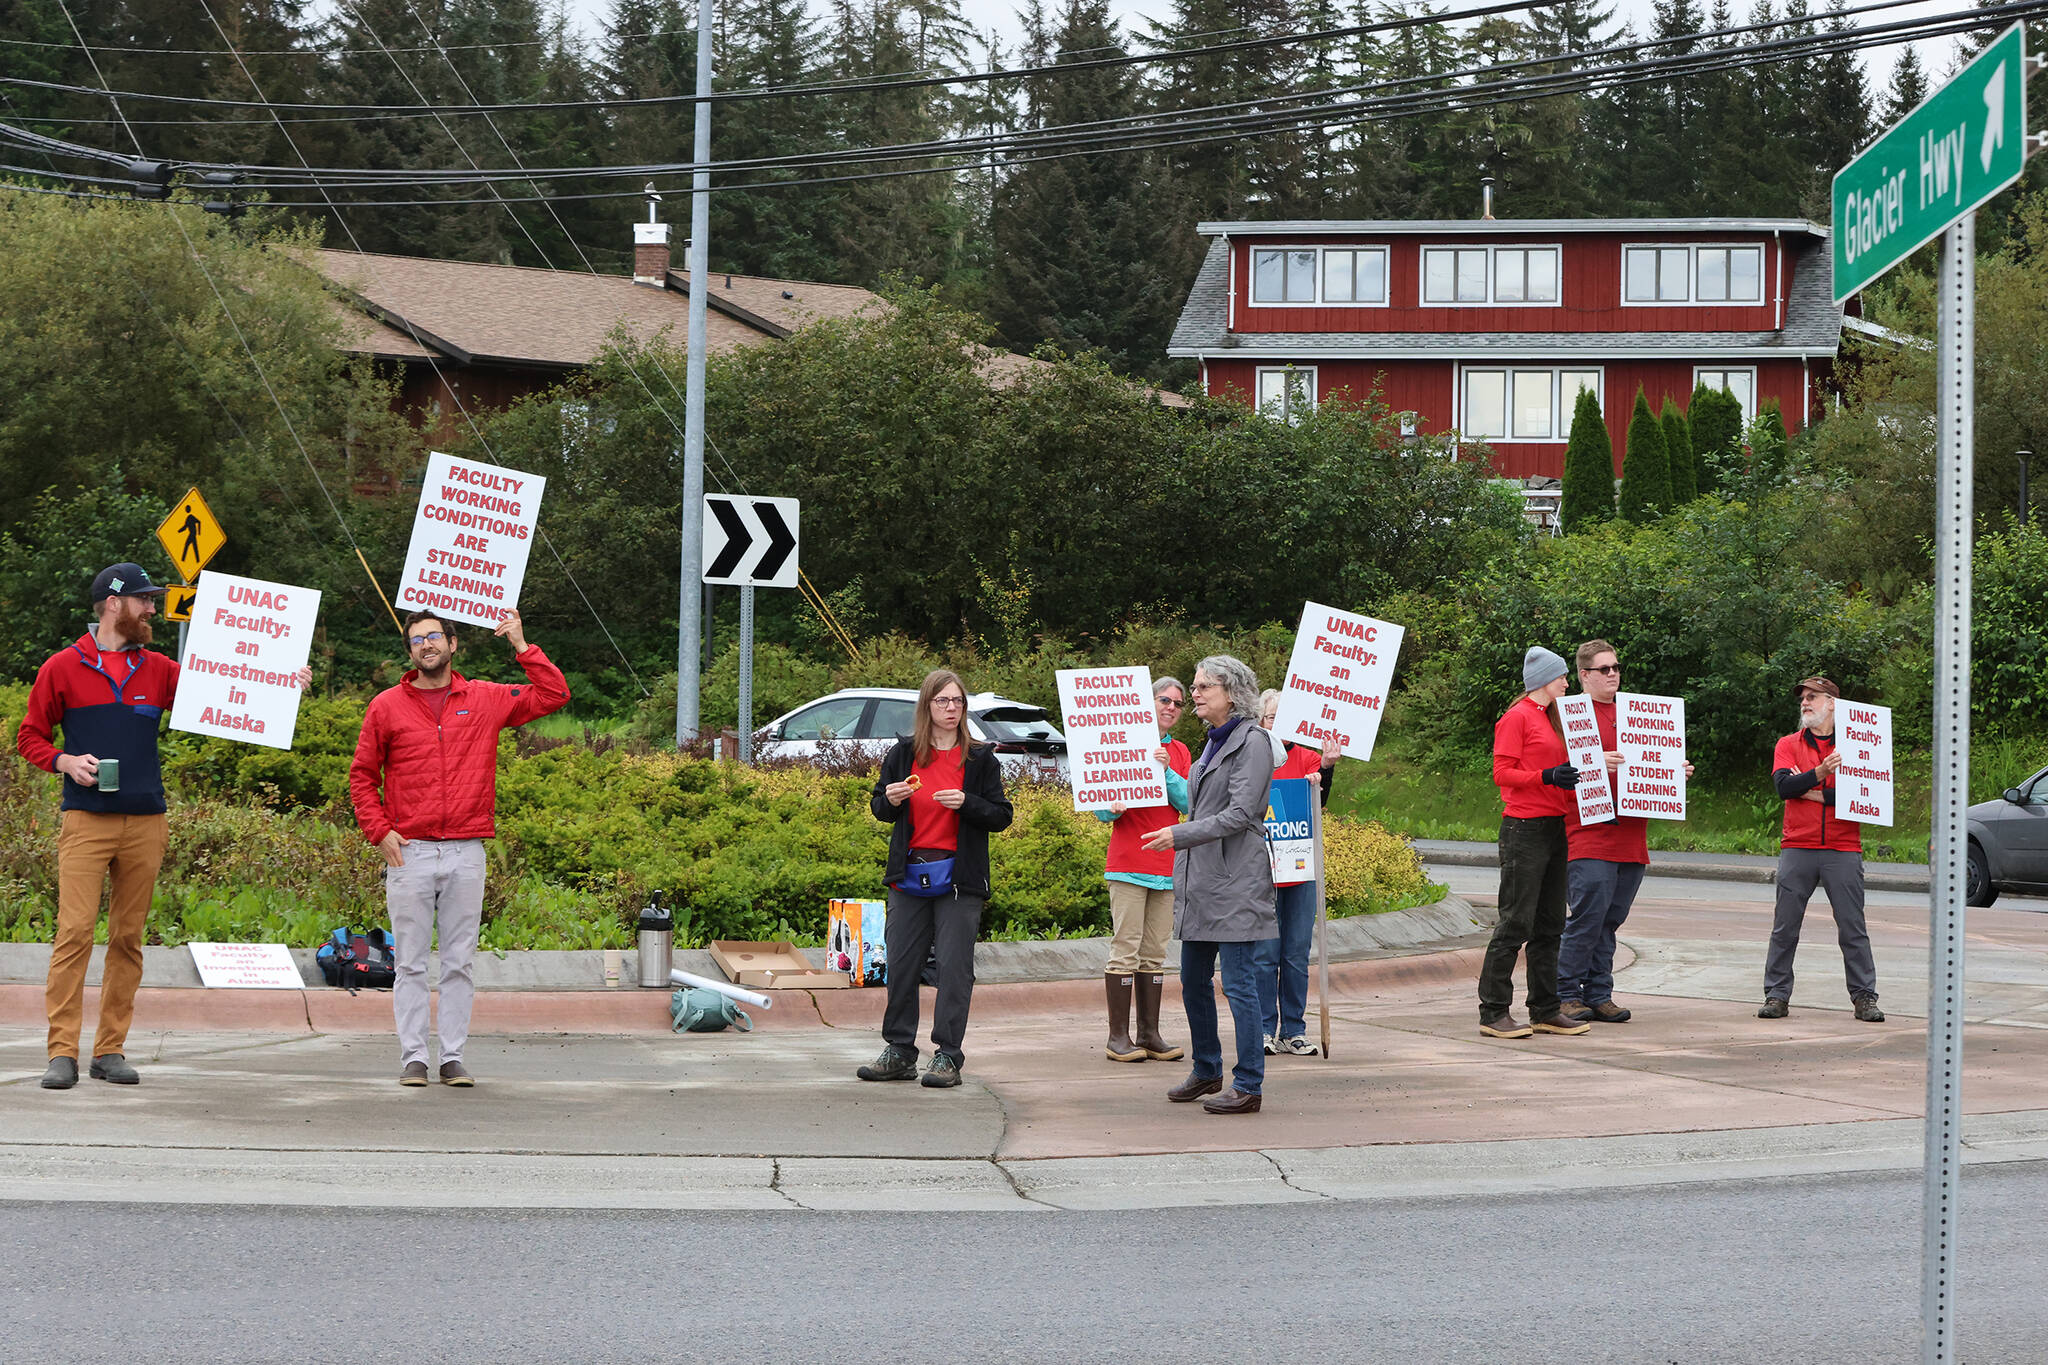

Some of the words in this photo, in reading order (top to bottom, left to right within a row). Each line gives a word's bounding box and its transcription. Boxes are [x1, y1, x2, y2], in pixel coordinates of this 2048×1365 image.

[1844, 166, 1906, 264] Glacier
[1920, 122, 1966, 210] Hwy
[448, 466, 523, 495] FACULTY
[441, 485, 521, 517] WORKING
[423, 504, 529, 540] CONDITIONS
[453, 533, 489, 553] ARE
[427, 548, 507, 578] STUDENT
[418, 568, 504, 600] LEARNING
[228, 585, 289, 611] UNAC
[403, 587, 508, 623] CONDITIONS
[214, 608, 291, 639] Faculty:
[1327, 616, 1377, 643] UNAC
[235, 641, 259, 657] an
[1314, 635, 1377, 666] Faculty:
[188, 653, 297, 689] Investment
[1329, 665, 1351, 681] an
[1074, 674, 1134, 689] FACULTY
[228, 686, 247, 705] in
[1290, 673, 1381, 711] Investment
[1074, 693, 1141, 709] WORKING
[1564, 701, 1586, 714] FACULTY
[1629, 700, 1672, 715] FACULTY
[199, 707, 265, 734] Alaska
[1068, 711, 1153, 728] CONDITIONS
[1321, 703, 1337, 721] in
[1849, 709, 1878, 726] UNAC
[1568, 719, 1593, 731] WORKING
[1627, 716, 1675, 732] WORKING
[1100, 731, 1127, 745] ARE
[1295, 720, 1351, 747] Alaska
[1620, 732, 1683, 748] CONDITIONS
[1846, 726, 1882, 747] Faculty:
[1568, 735, 1600, 750] CONDITIONS
[1083, 748, 1147, 765] STUDENT
[1582, 753, 1593, 765] ARE
[1641, 750, 1662, 763] ARE
[1858, 749, 1870, 761] an
[1084, 767, 1153, 784] LEARNING
[1579, 768, 1602, 782] STUDENT
[1628, 765, 1675, 780] STUDENT
[1838, 762, 1890, 782] Investment
[1078, 785, 1163, 803] CONDITIONS
[1582, 785, 1607, 801] LEARNING
[1627, 782, 1677, 797] LEARNING
[1860, 787, 1870, 797] in
[1264, 805, 1276, 821] A
[1581, 802, 1613, 817] CONDITIONS
[1621, 797, 1683, 814] CONDITIONS
[1849, 799, 1880, 817] Alaska
[1263, 820, 1309, 840] TRONG
